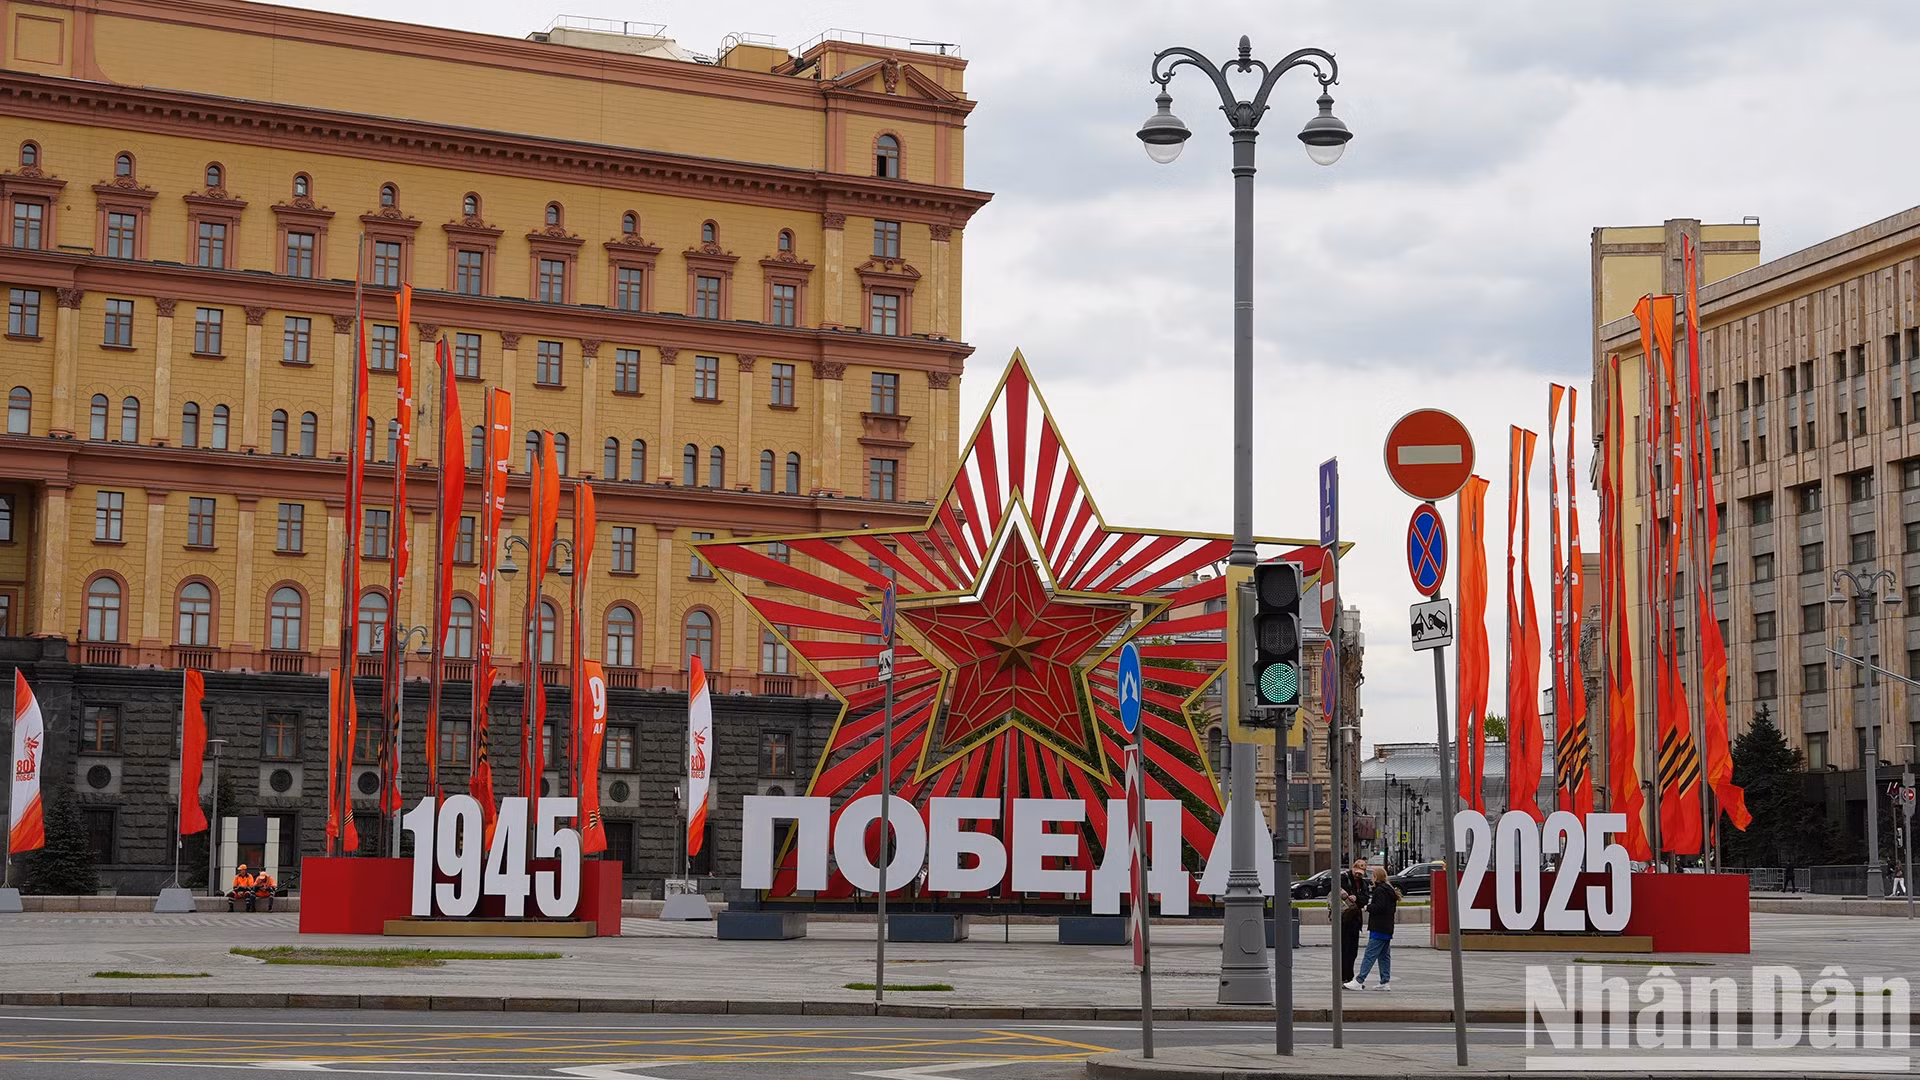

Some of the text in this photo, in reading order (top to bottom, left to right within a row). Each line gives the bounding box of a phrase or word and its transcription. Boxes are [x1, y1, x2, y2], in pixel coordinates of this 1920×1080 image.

[589, 676, 605, 720] 9
[16, 759, 31, 773] 80
[403, 795, 582, 916] 1945
[741, 795, 1274, 915] ПОБЕДА
[1454, 810, 1632, 931] 2025
